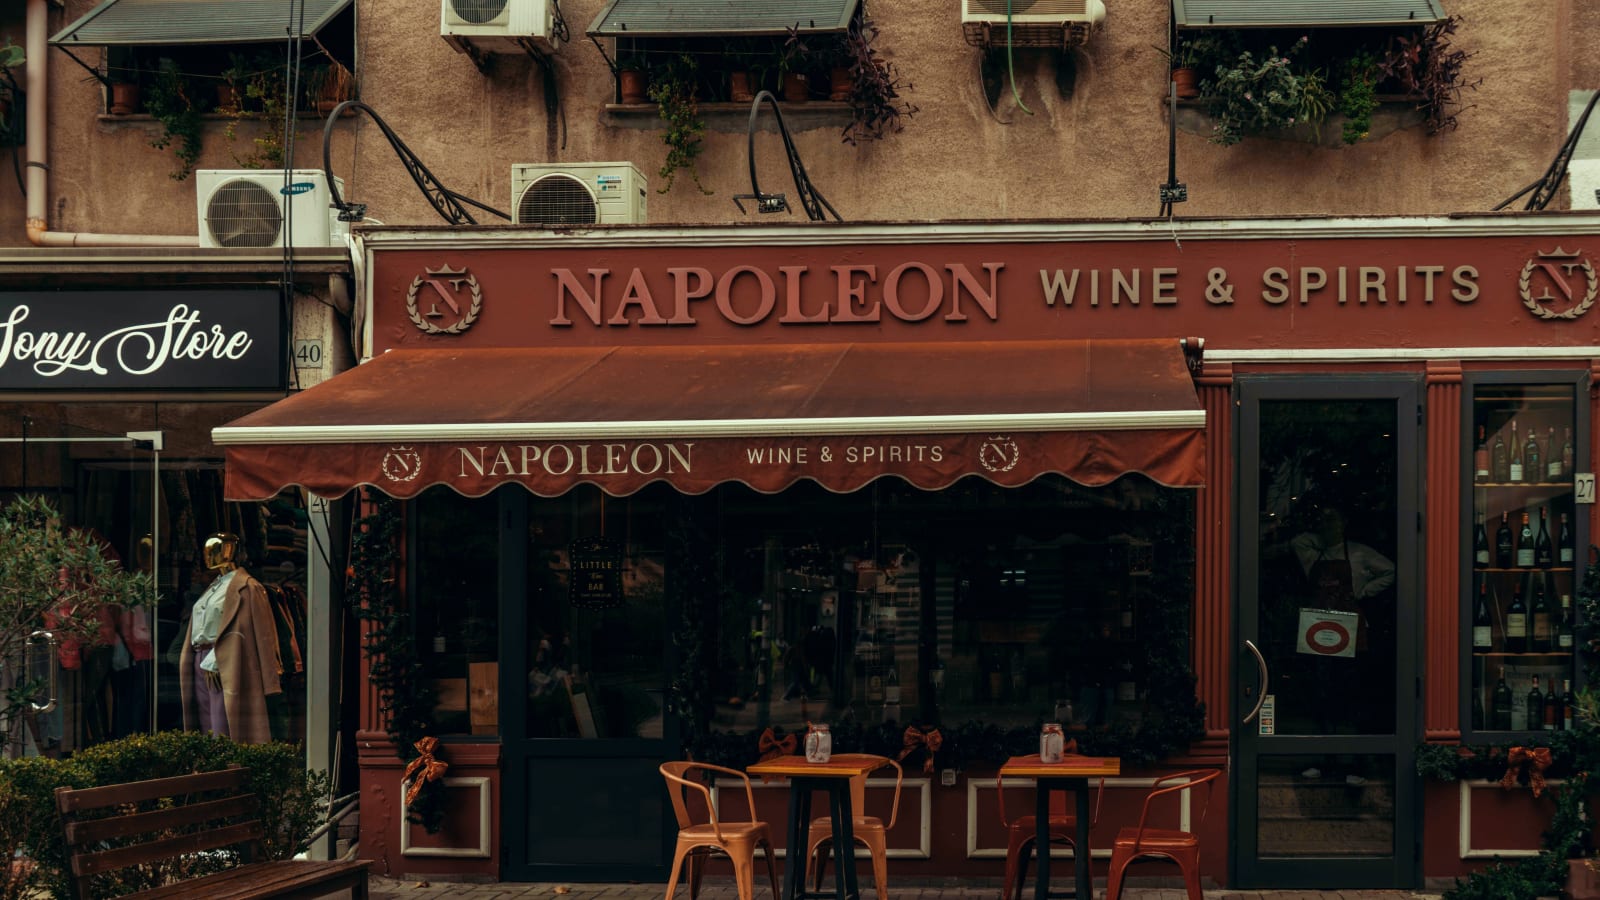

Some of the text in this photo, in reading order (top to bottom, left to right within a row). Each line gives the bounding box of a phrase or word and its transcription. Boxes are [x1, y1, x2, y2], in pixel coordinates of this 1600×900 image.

[549, 262, 1480, 326] NAPOLEON WINE & SPIRITS
[91, 303, 252, 375] Store
[297, 344, 321, 363] 40
[458, 443, 944, 477] NAPOLEON WINE & SPIRITS
[1577, 479, 1593, 497] 27
[580, 561, 612, 569] LITTLE
